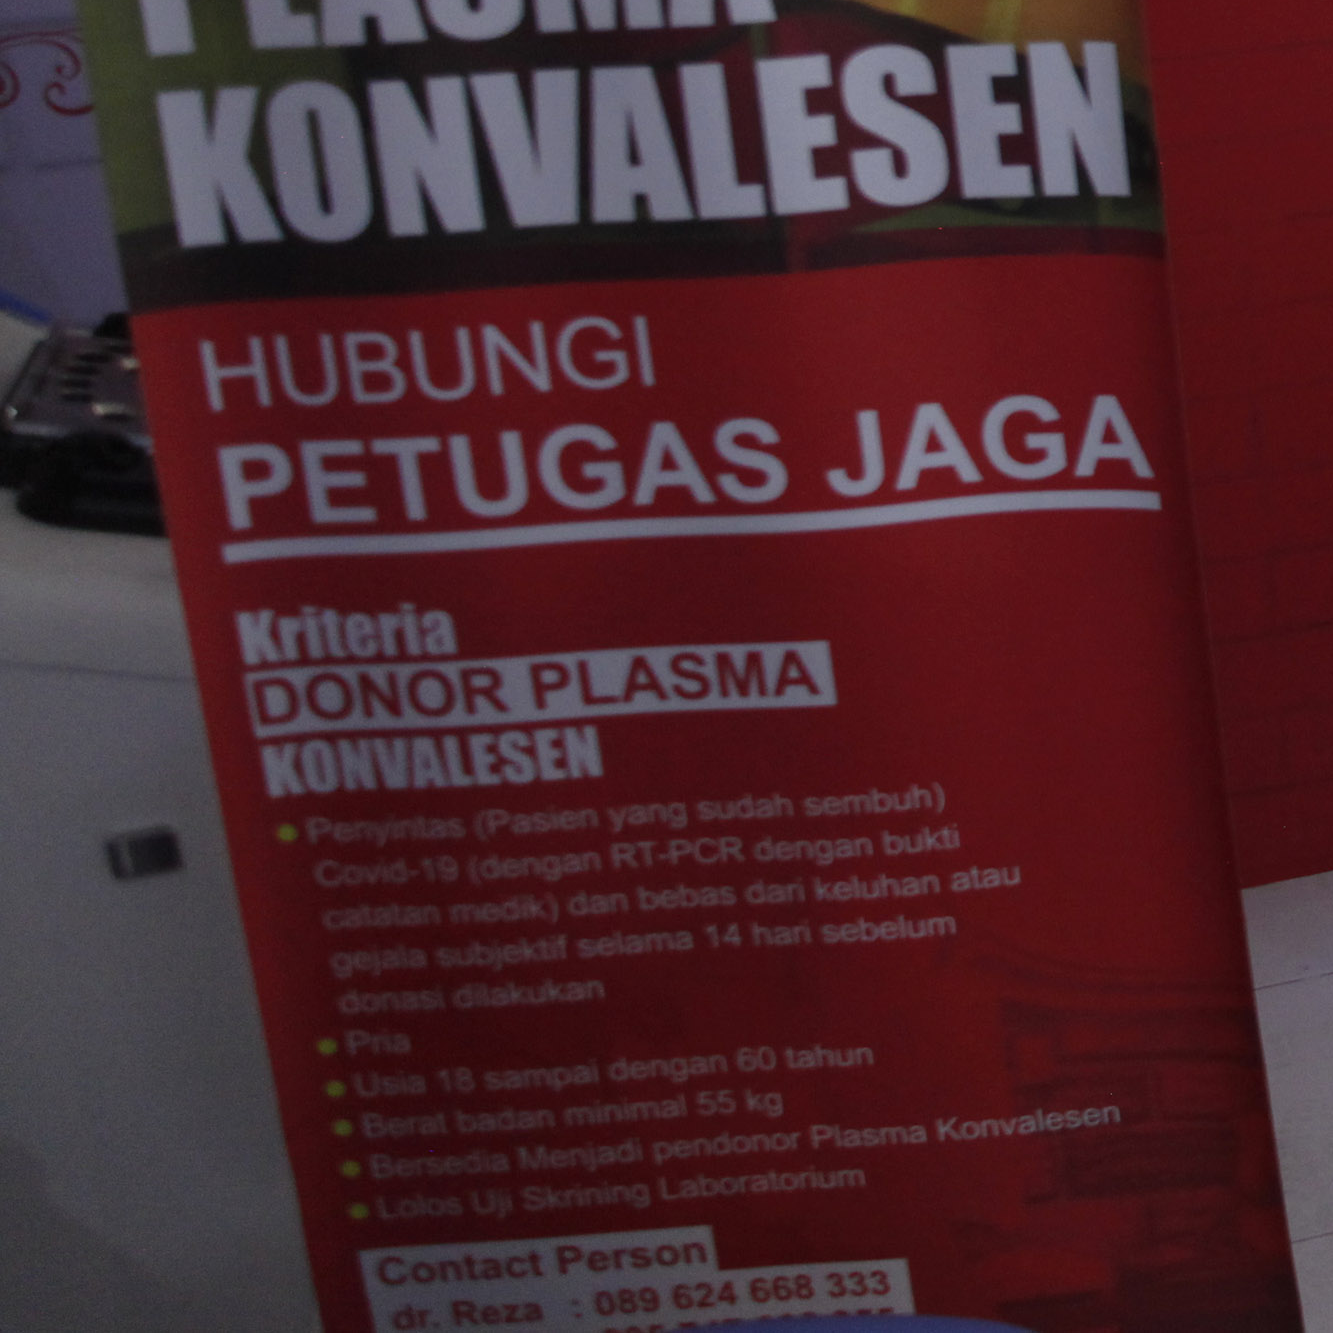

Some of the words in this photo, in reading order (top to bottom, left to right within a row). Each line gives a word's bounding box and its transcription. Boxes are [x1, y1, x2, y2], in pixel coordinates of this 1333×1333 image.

[155, 40, 1132, 248] KONVALESEN
[198, 316, 658, 413] HUBUNGI
[217, 418, 790, 531] PETUGAS
[826, 394, 1156, 499] JAGA
[235, 602, 459, 666] Kriteria
[251, 667, 509, 726] DONOR
[529, 648, 822, 711] PLASMA
[260, 725, 604, 798] KONVALESEN
[305, 816, 466, 848] Penyintas
[472, 807, 600, 841] (Pasien
[607, 802, 688, 834] yang
[697, 793, 795, 821] sudah
[803, 781, 947, 817] sembuh)
[313, 856, 460, 888] Covid-19
[467, 850, 602, 886] (dengan
[610, 836, 745, 868] RT-PCR
[754, 835, 874, 867] dengan
[881, 823, 962, 857] bukti
[321, 902, 442, 930] catatan
[448, 893, 559, 925] medik)
[566, 889, 629, 916] dan
[636, 883, 737, 911] bebas
[744, 877, 806, 905] dari
[812, 873, 941, 902] keluhan
[950, 864, 1022, 893] atau
[330, 946, 428, 979] gejala
[434, 934, 567, 971] subjektif
[574, 929, 695, 958] selama
[704, 922, 742, 949] 14
[751, 919, 812, 947] hari
[820, 914, 958, 946] sebelum
[338, 987, 446, 1015] donasi
[453, 979, 606, 1010] dilakukan
[344, 1029, 412, 1056] Pria
[353, 1069, 427, 1098] Usia
[438, 1066, 476, 1093] 18
[483, 1059, 600, 1092] sampai
[607, 1052, 729, 1084] dengan
[736, 1045, 777, 1073] 60
[784, 1042, 875, 1071] tahun
[361, 1111, 448, 1139] Berat
[454, 1105, 556, 1134] badan
[562, 1094, 688, 1127] minimal
[696, 1088, 736, 1116] 55
[744, 1088, 784, 1119] kg
[369, 1150, 510, 1180] Bersedia
[516, 1137, 644, 1172] Menjadi
[651, 1130, 801, 1165] pendonor
[808, 1123, 928, 1150] Plasma
[934, 1104, 1122, 1143] Konvalesen
[376, 1193, 464, 1221] Lolos
[470, 1188, 513, 1220] Uji
[521, 1180, 651, 1212] Skrining
[659, 1167, 866, 1201] Laboratorium
[377, 1250, 544, 1286] Contact
[555, 1239, 708, 1275] Person
[392, 1303, 441, 1331] dr.
[451, 1299, 545, 1327] Reza
[594, 1286, 661, 1316] 089
[672, 1281, 738, 1310] 624
[750, 1273, 815, 1304] 668
[825, 1269, 891, 1299] 333
